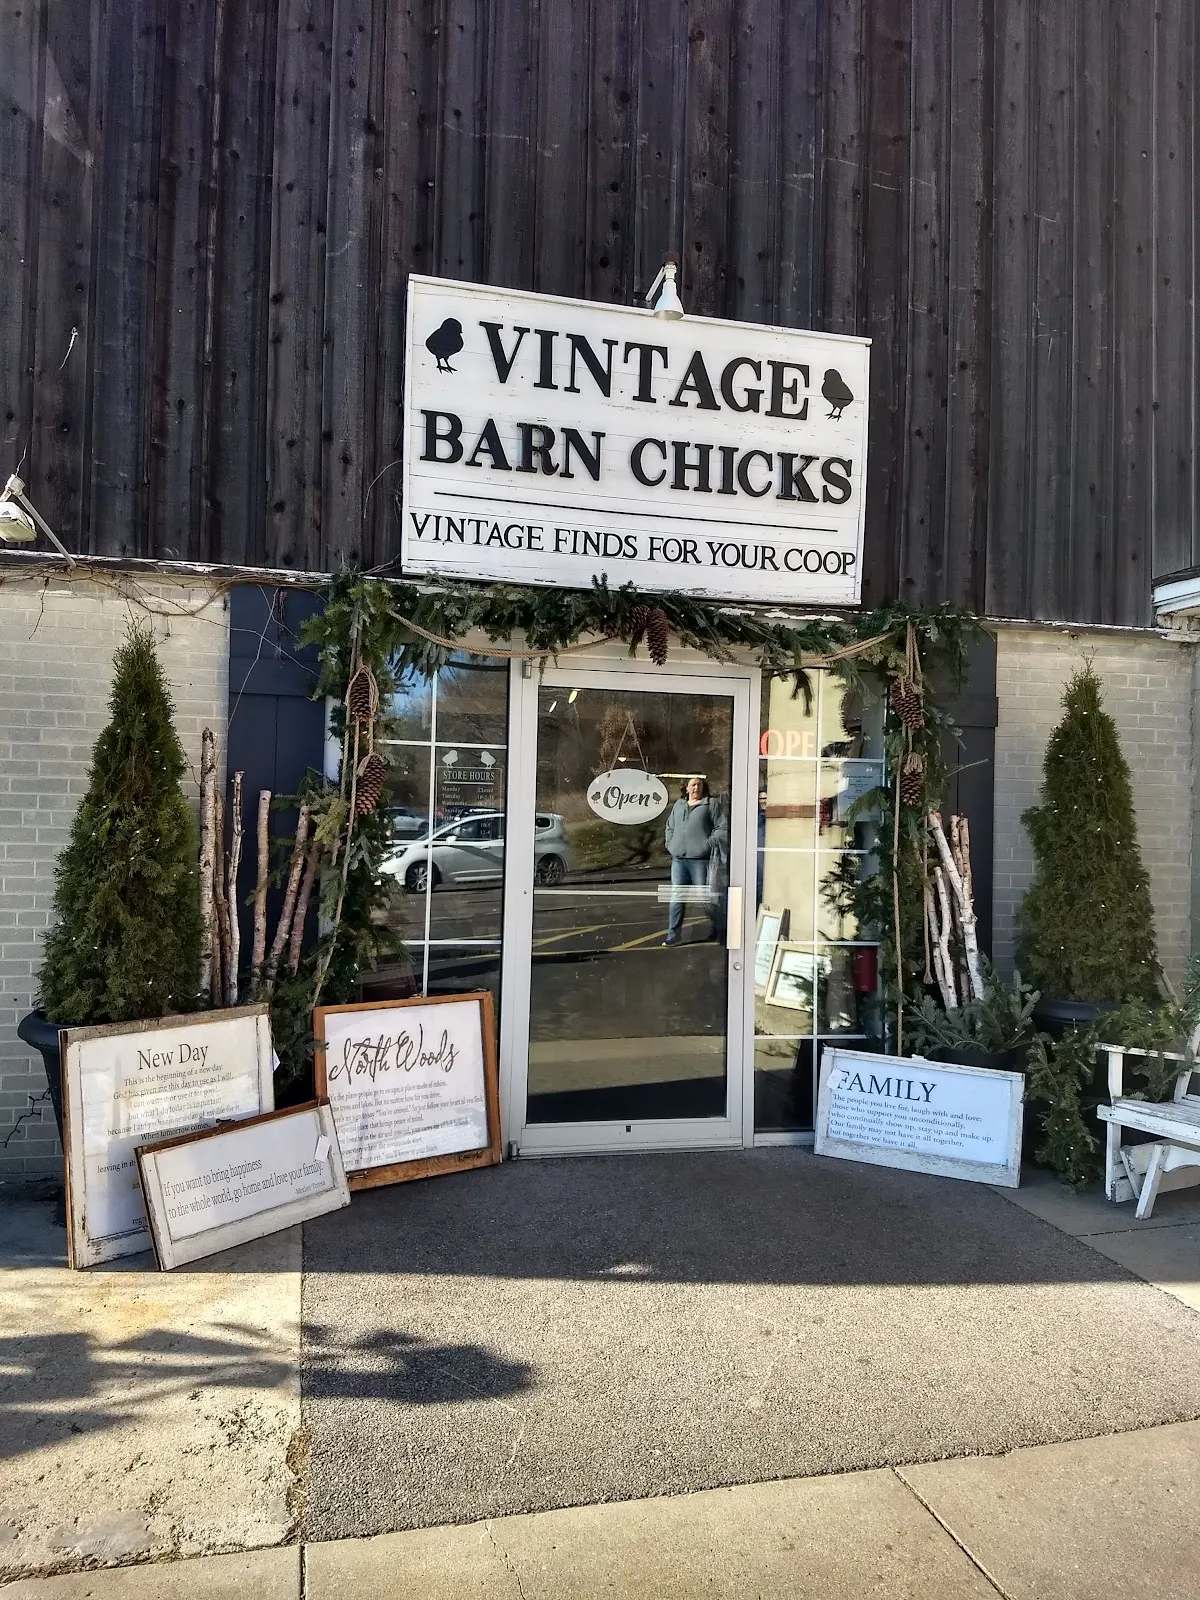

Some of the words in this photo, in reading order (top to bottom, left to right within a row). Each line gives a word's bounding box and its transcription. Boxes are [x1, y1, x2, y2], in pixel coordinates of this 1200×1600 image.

[479, 320, 810, 420] VINTAGE
[420, 409, 606, 482] BARN
[630, 437, 853, 505] CHICKS
[409, 512, 544, 552] VINTAGE
[553, 528, 639, 560] FINDS
[648, 536, 702, 565] FOR
[705, 541, 781, 572] YOUR
[783, 548, 857, 576] COOP
[443, 770, 467, 780] STORE
[469, 771, 495, 780] HOURS
[603, 786, 650, 810] Open
[137, 1048, 174, 1070] New
[178, 1043, 209, 1067] Day
[328, 1034, 391, 1085] North
[395, 1024, 460, 1073] Woods
[124, 1077, 138, 1087] This
[145, 1074, 155, 1084] the
[156, 1070, 186, 1084] beginning
[187, 1068, 195, 1076] of
[168, 1082, 180, 1091] this
[180, 1079, 192, 1090] day
[837, 1069, 936, 1102] FAMILY
[832, 1094, 845, 1102] The
[846, 1097, 868, 1106] people
[870, 1100, 883, 1109] you
[911, 1106, 931, 1115] laugh
[932, 1110, 949, 1118] with
[832, 1102, 849, 1111] those
[866, 1109, 893, 1118] support
[894, 1113, 907, 1121] you
[140, 1132, 160, 1141] When
[159, 1127, 191, 1139] tomorrow
[830, 1119, 844, 1128] Our
[846, 1120, 868, 1131] family
[868, 1127, 883, 1136] may
[884, 1128, 896, 1136] not
[898, 1130, 914, 1139] have
[923, 1134, 932, 1142] all
[831, 1111, 846, 1119] who
[846, 1114, 884, 1125] continually
[885, 1120, 903, 1128] show
[944, 1130, 959, 1138] and
[960, 1133, 980, 1141] make
[842, 1131, 870, 1141] together
[882, 1137, 898, 1146] have
[97, 1162, 121, 1173] leaving
[164, 1182, 171, 1197] If
[170, 1182, 185, 1199] you
[185, 1177, 203, 1191] want
[202, 1174, 212, 1186] to
[211, 1168, 230, 1185] bring
[229, 1158, 263, 1180] happiness
[168, 1207, 177, 1220] to
[177, 1201, 189, 1216] the
[189, 1194, 212, 1213] whole
[233, 1189, 243, 1203] go
[242, 1181, 262, 1199] home
[261, 1174, 275, 1190] and
[274, 1171, 288, 1186] love
[288, 1168, 303, 1185] your
